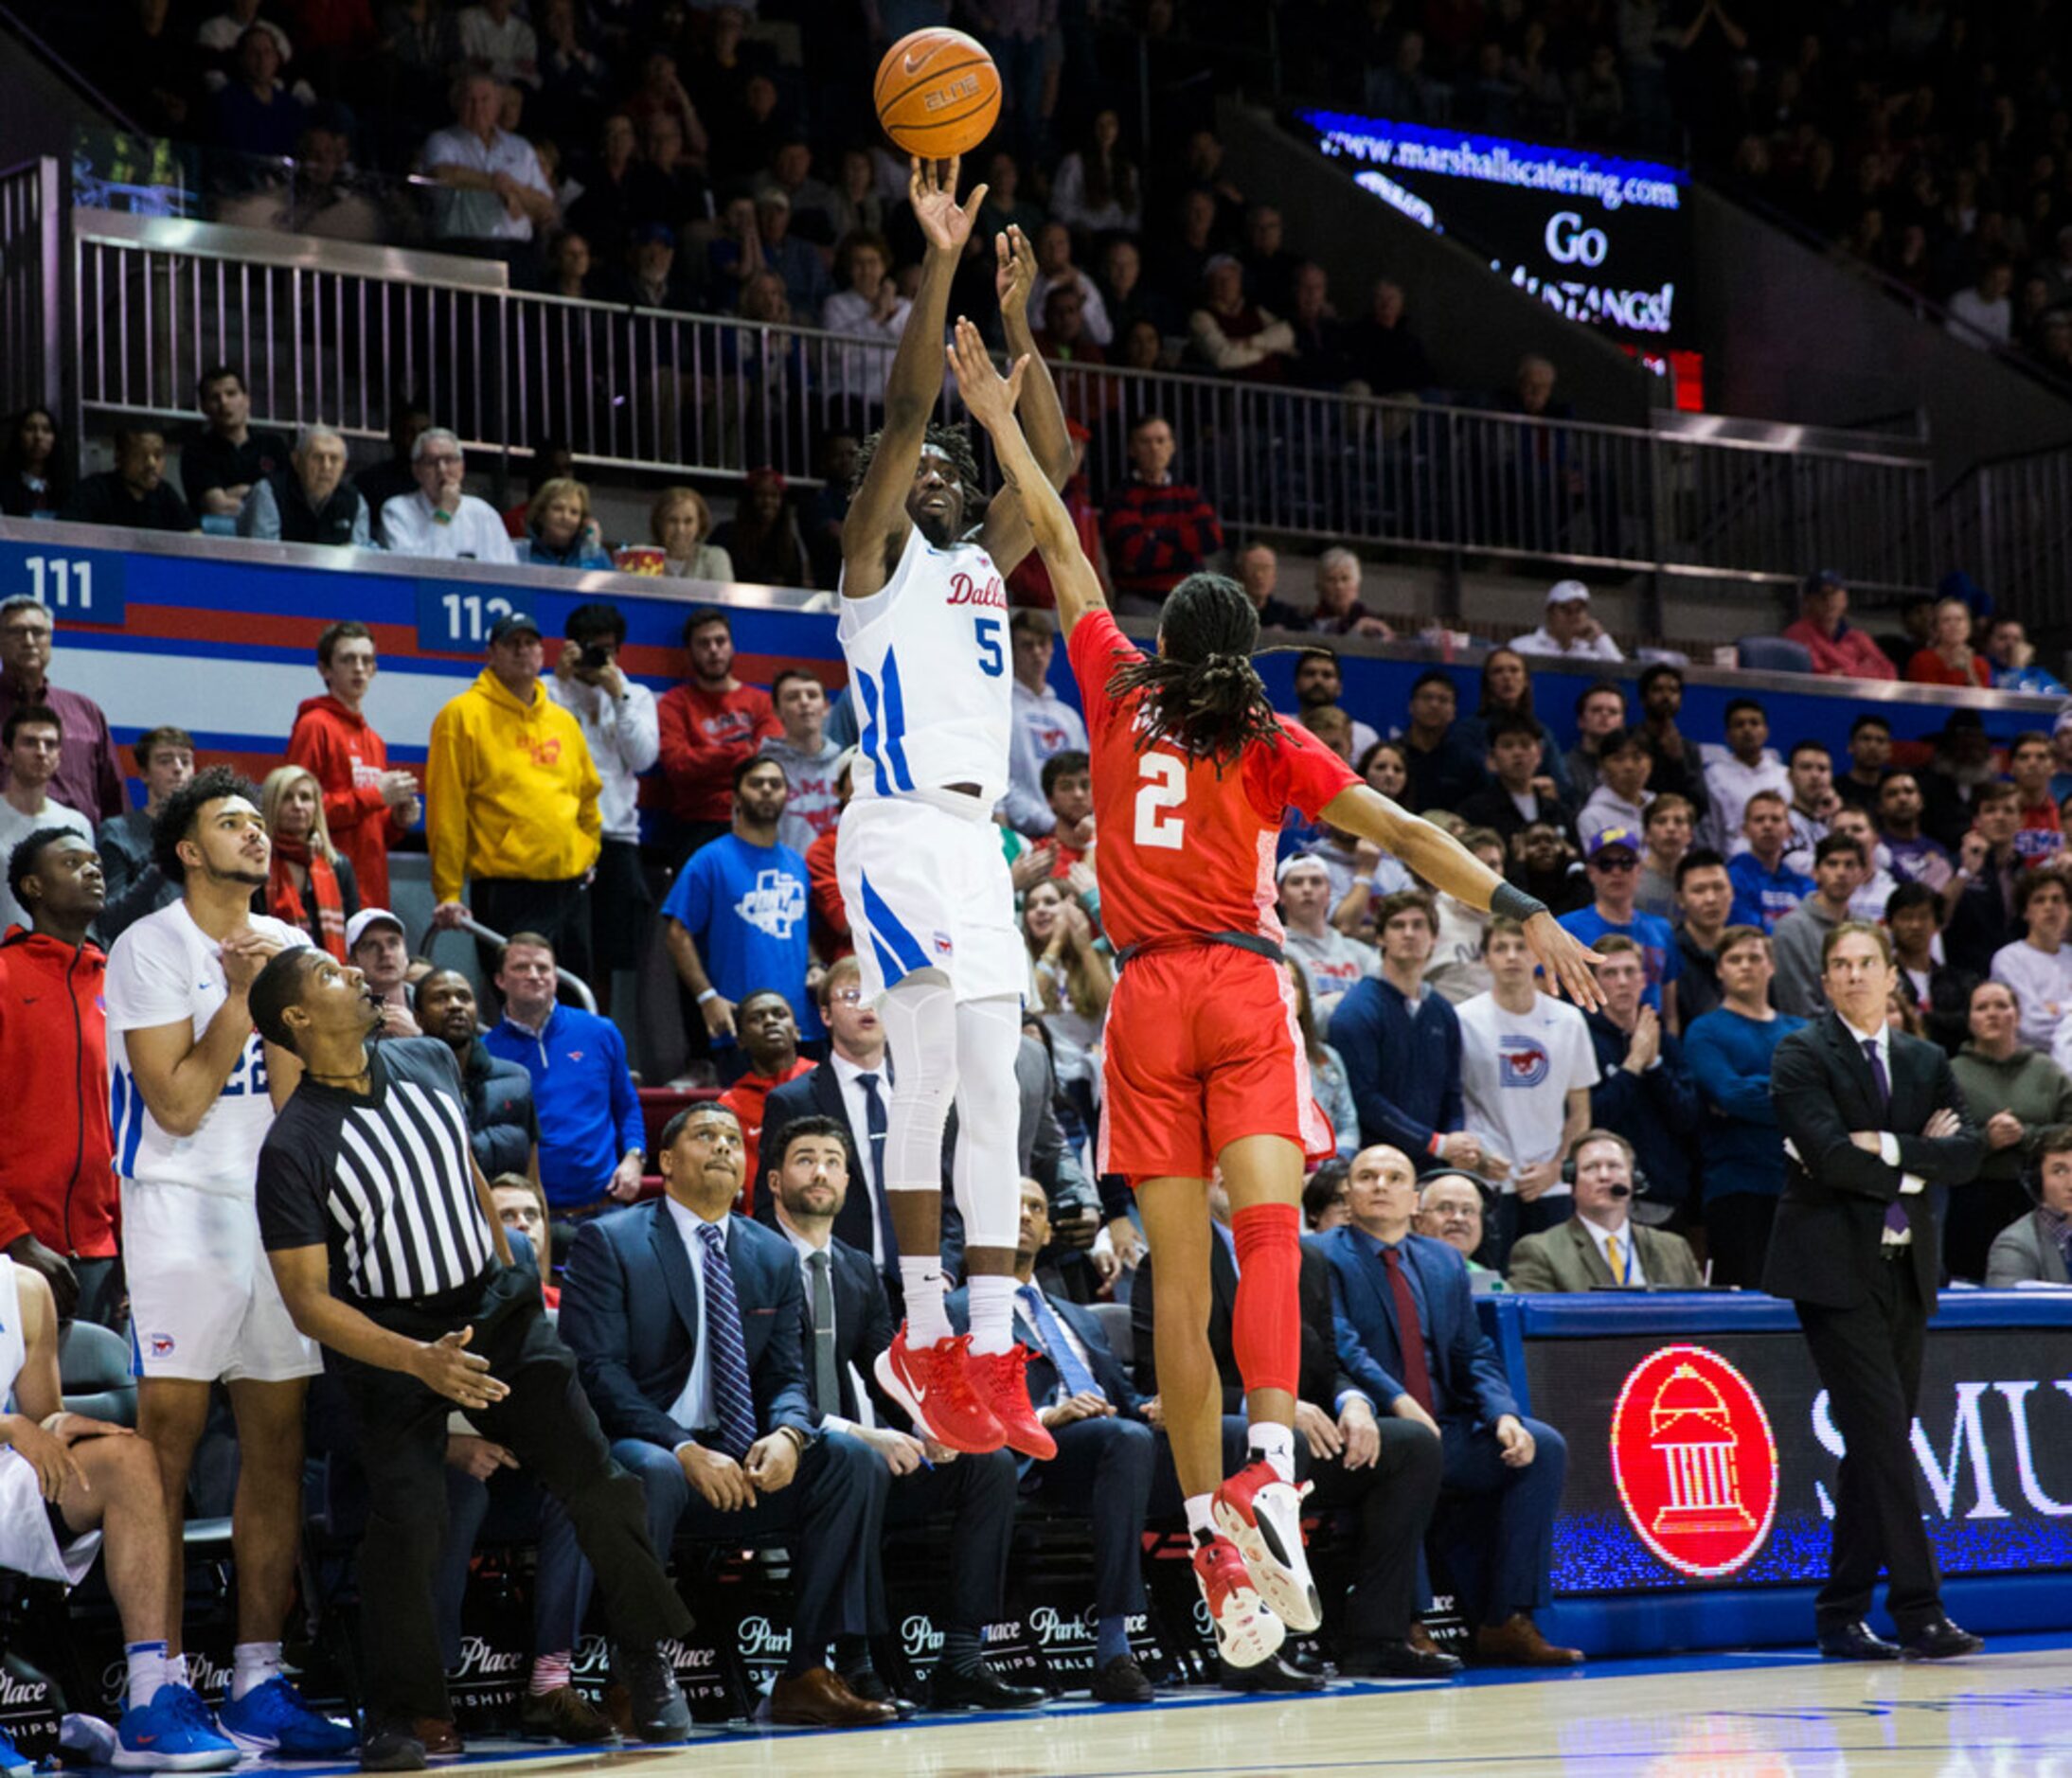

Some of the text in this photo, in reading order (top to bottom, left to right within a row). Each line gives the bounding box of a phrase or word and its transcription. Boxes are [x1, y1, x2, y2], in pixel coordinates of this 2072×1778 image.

[1545, 211, 1608, 267] Go
[26, 556, 92, 608] 111
[973, 617, 1005, 677] 5
[1134, 752, 1187, 850] 2
[1029, 1607, 1086, 1645] Park
